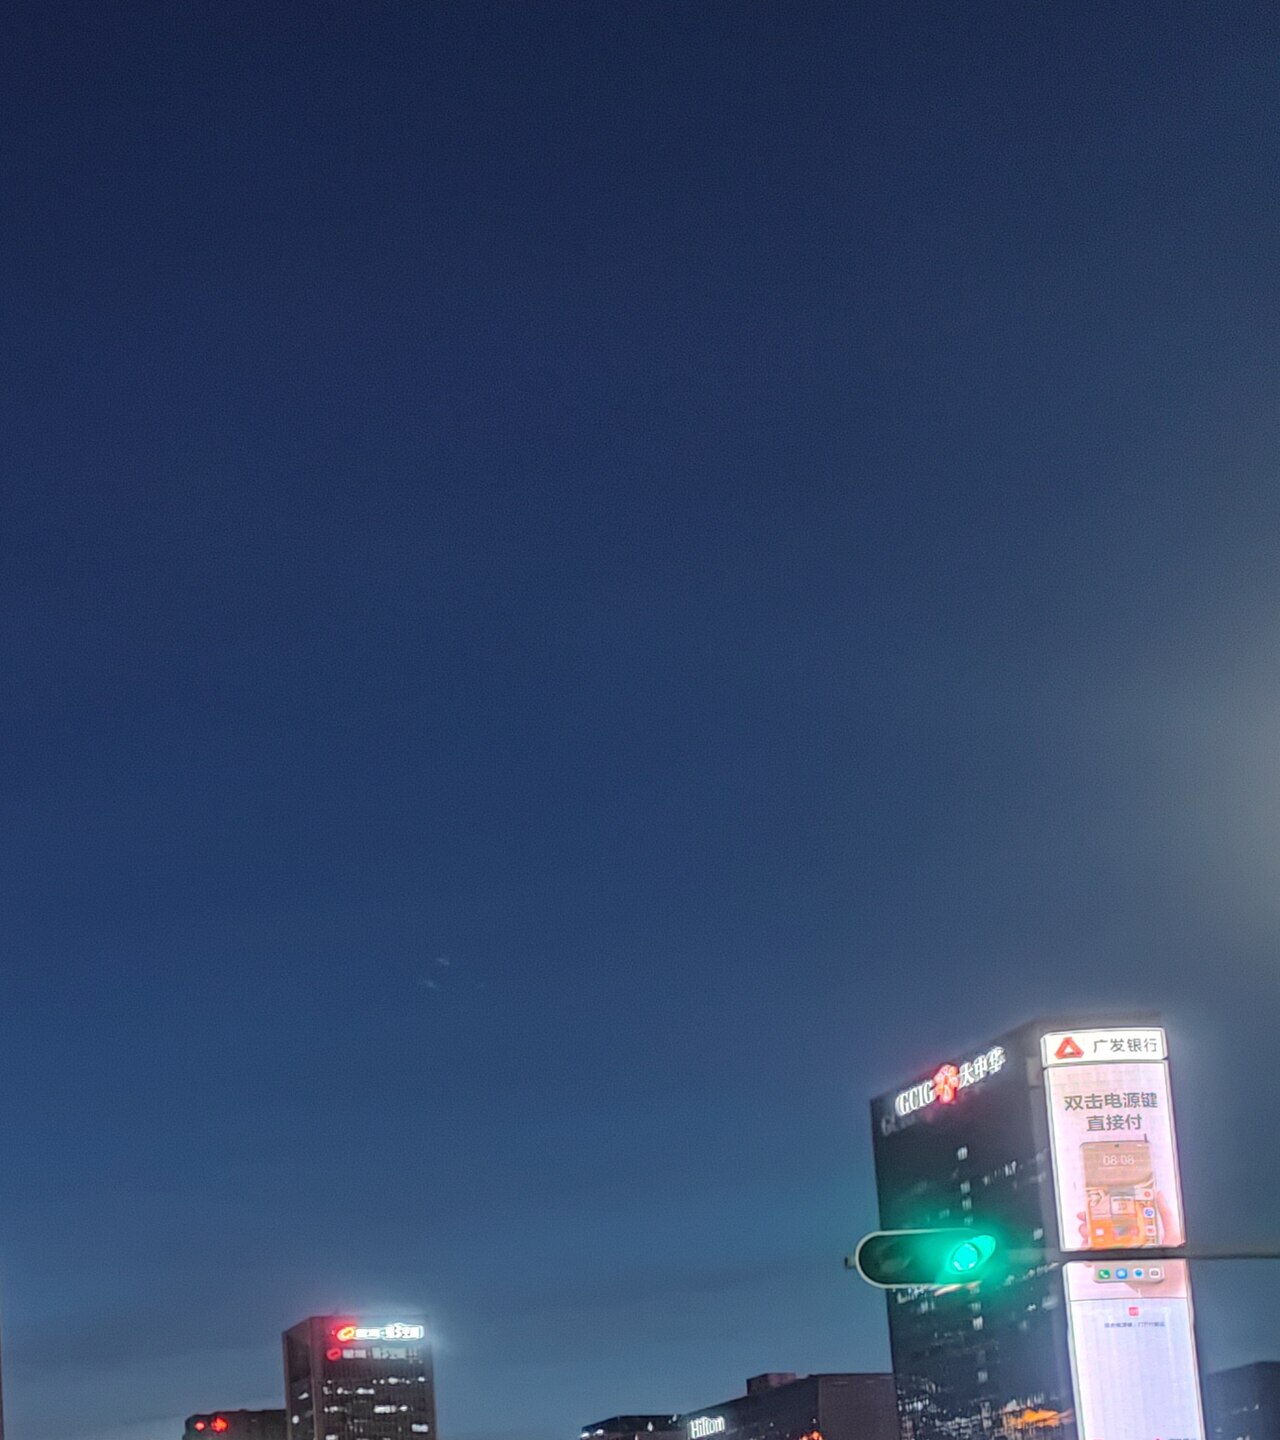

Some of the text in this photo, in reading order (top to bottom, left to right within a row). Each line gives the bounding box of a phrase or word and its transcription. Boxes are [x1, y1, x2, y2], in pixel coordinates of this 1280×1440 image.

[1093, 1038, 1157, 1053] 广发银行
[958, 1046, 1006, 1089] 大中华
[1064, 1092, 1158, 1111] 双击电源键
[1086, 1114, 1142, 1132] 直接付
[690, 1416, 725, 1439] Hilton
